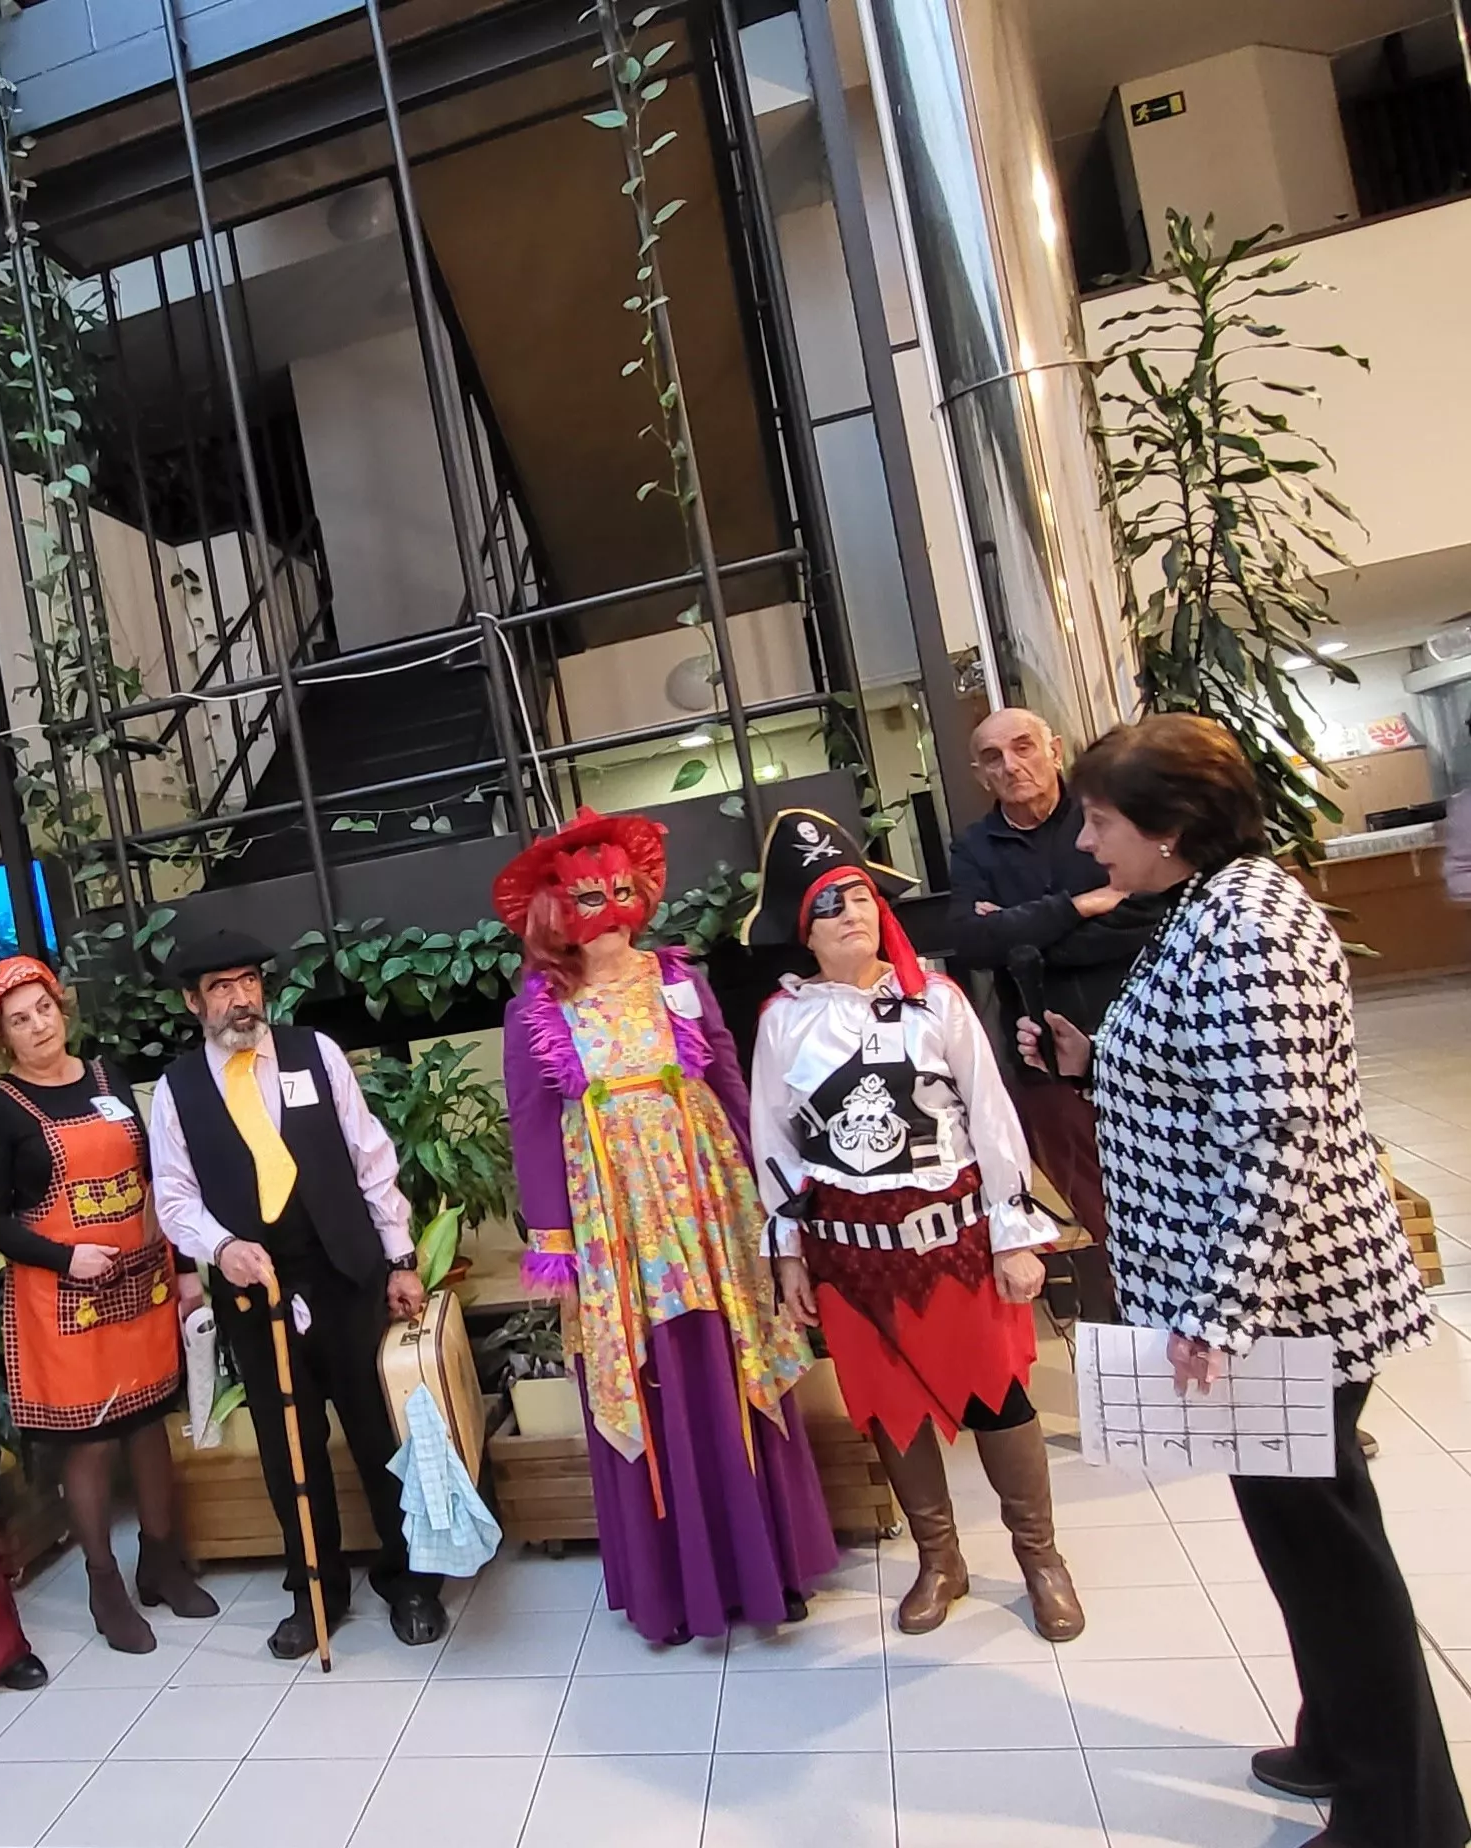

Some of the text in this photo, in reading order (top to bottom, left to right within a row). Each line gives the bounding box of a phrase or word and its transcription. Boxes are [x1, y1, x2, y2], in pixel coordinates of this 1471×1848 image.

[864, 1032, 882, 1055] 4
[282, 1080, 295, 1100] 7
[99, 1102, 114, 1117] 5
[1259, 1439, 1284, 1451] 4
